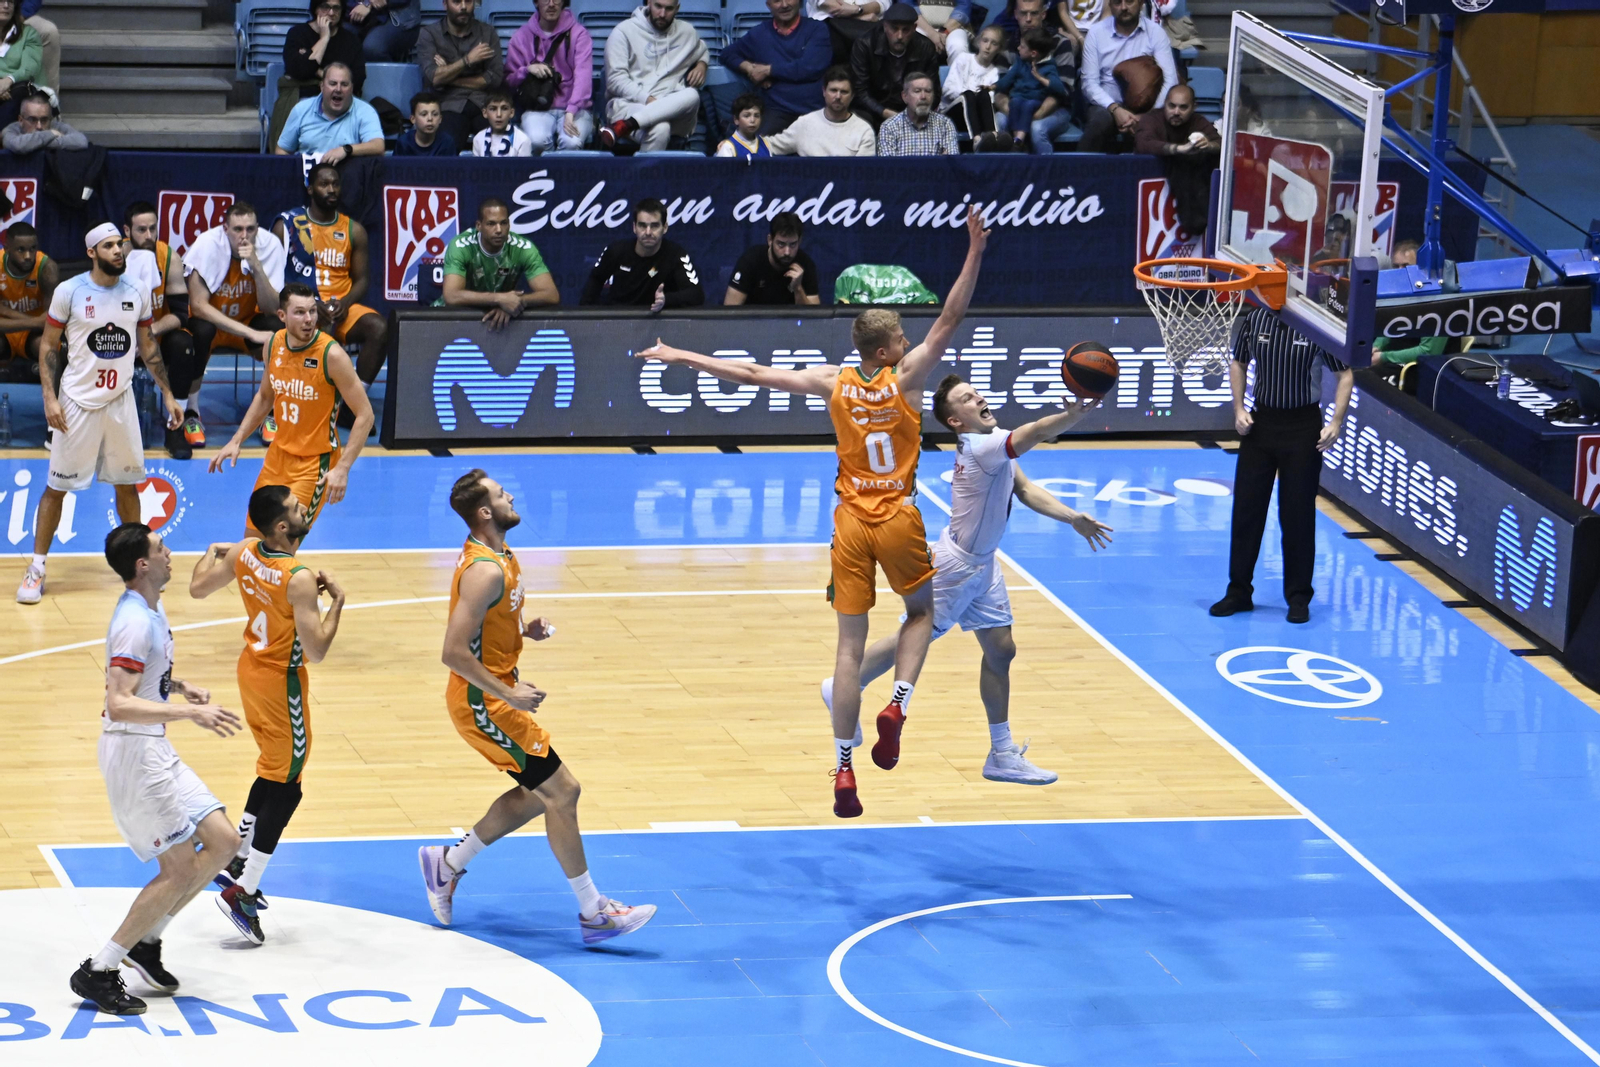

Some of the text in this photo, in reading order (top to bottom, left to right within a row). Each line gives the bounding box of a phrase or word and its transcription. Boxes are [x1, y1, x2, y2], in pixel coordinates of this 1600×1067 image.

[509, 169, 630, 235] Éche
[732, 181, 885, 228] andar
[1383, 298, 1561, 338] endesa
[94, 332, 126, 342] Estrella
[95, 341, 125, 352] Galicia
[95, 369, 118, 390] 30
[281, 401, 300, 425] 13
[865, 431, 897, 476] 0
[158, 467, 185, 493] GALICIA
[173, 507, 187, 528] 1906
[251, 610, 269, 652] 4
[0, 987, 547, 1043] BANCA
